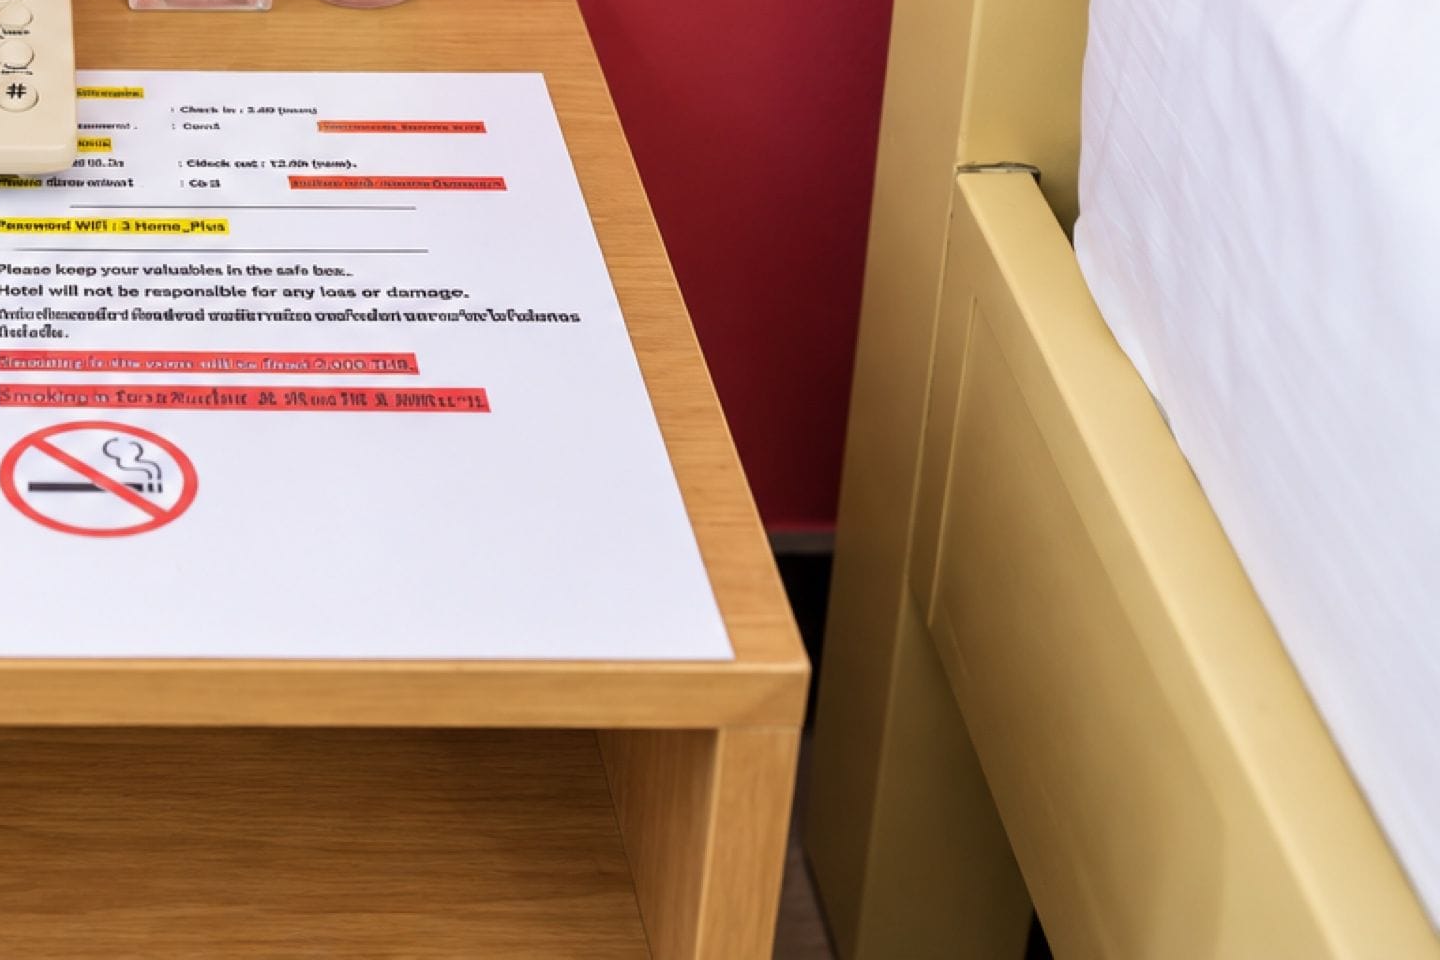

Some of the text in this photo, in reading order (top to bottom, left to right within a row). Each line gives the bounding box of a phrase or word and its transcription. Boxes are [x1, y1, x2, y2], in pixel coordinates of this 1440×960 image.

[101, 266, 139, 277] your
[142, 264, 223, 275] valuables
[246, 265, 272, 276] the
[48, 285, 78, 297] will
[84, 286, 113, 297] not
[118, 285, 139, 297] be
[144, 285, 246, 299] responsible
[252, 286, 277, 297] for
[283, 288, 315, 299] any
[320, 286, 356, 298] loss
[362, 288, 381, 298] or
